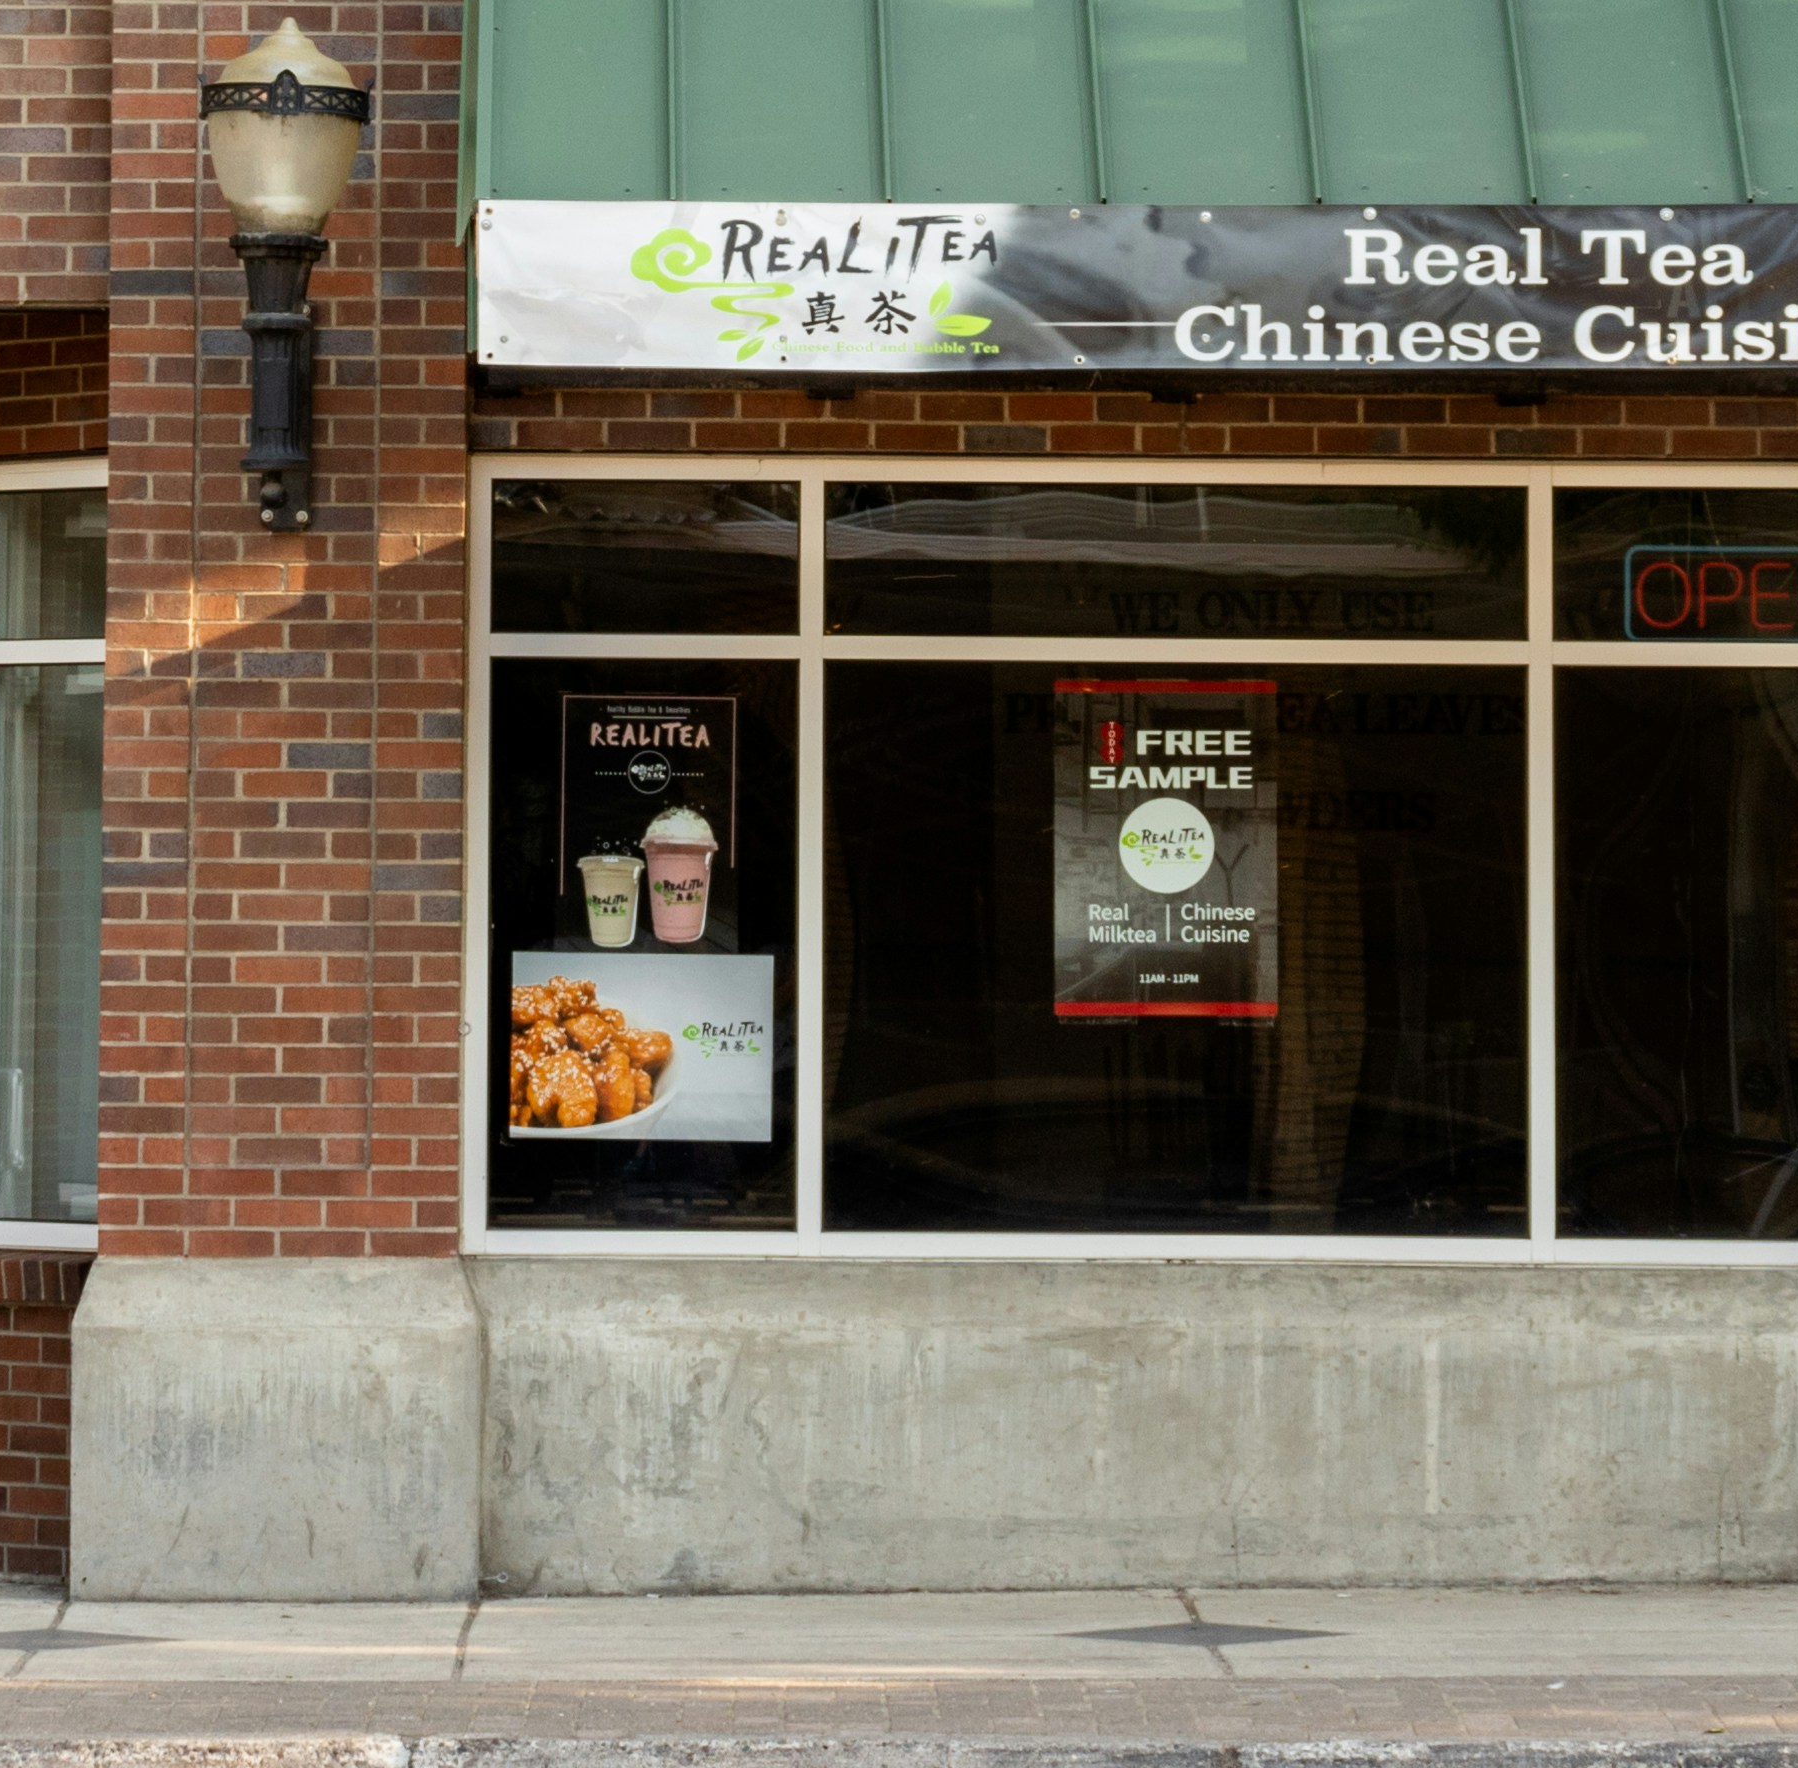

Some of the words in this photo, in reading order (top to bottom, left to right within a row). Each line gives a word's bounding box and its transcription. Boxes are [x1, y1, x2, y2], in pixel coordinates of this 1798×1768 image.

[1344, 228, 1549, 286] Real
[1581, 229, 1753, 286] Tea
[1175, 305, 1541, 364] Chinese
[835, 341, 874, 353] Food
[879, 341, 909, 353] and
[913, 341, 966, 353] Bubble
[969, 341, 1000, 354] Tea
[589, 722, 710, 748] REALITEA
[1137, 730, 1252, 755] FREE
[1089, 767, 1253, 789] SAMPLE
[1089, 904, 1130, 921] Real
[1180, 903, 1255, 922] Chinese
[1089, 925, 1157, 943] Milktea
[1180, 925, 1250, 943] Cuisine
